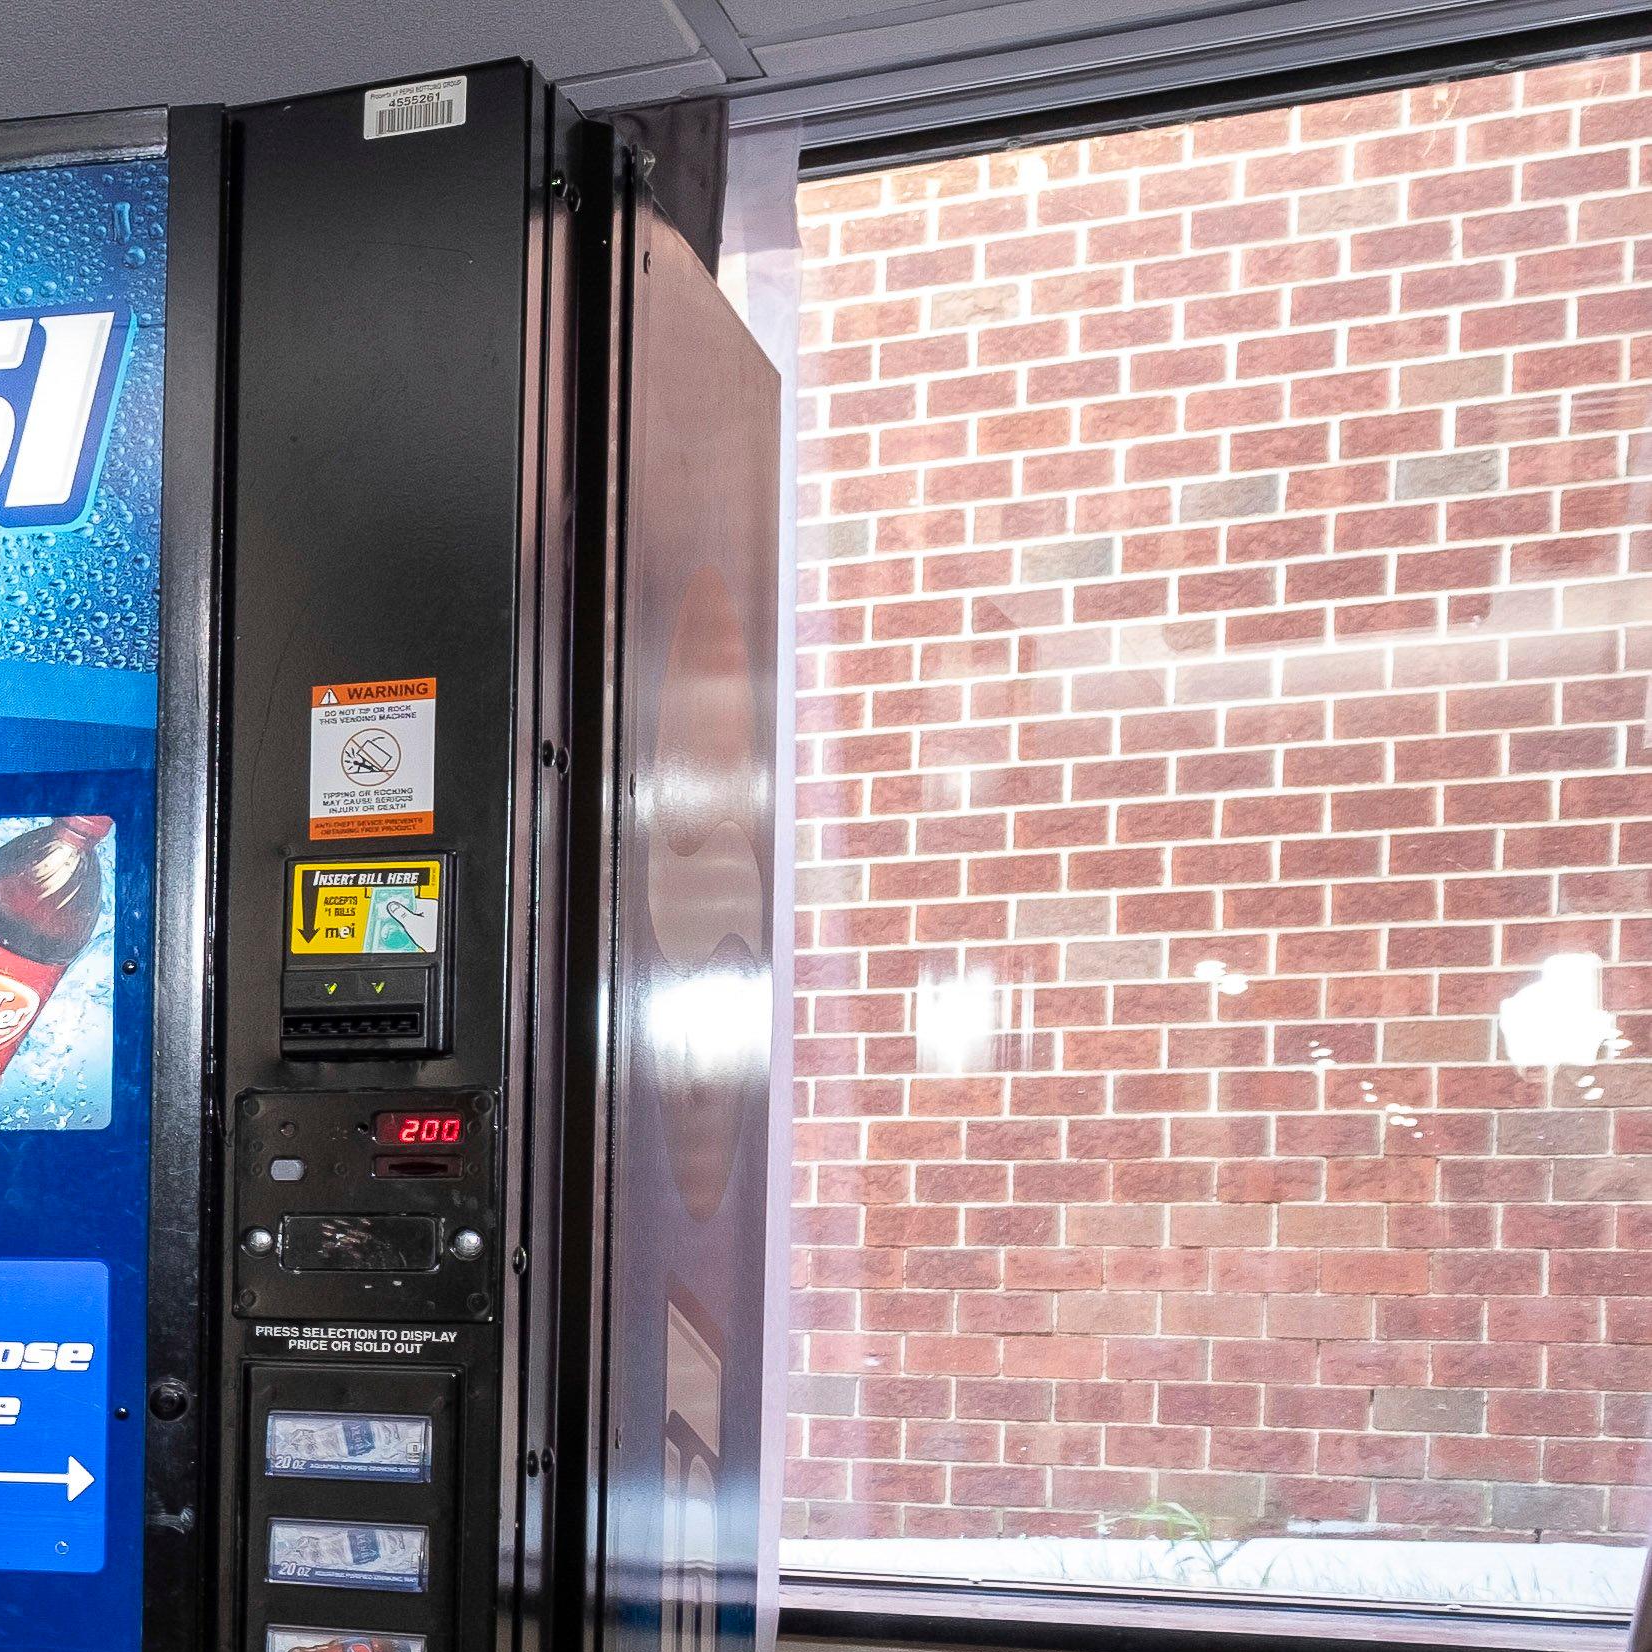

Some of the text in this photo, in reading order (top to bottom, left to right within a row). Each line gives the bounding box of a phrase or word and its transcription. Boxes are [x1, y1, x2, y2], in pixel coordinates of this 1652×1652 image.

[389, 92, 440, 107] 4555261
[347, 682, 429, 700] WARNING
[339, 708, 355, 716] NOT
[373, 706, 385, 714] OR
[388, 705, 412, 713] ROCK
[319, 711, 417, 725] THIS VENDING MACHINE
[323, 787, 413, 799] TIPPING OR ROCKING
[344, 798, 372, 806] CAUSE
[375, 795, 413, 804] SERIOUS
[329, 806, 359, 814] INJURY
[377, 803, 407, 811] DEATH
[313, 871, 354, 886] INSERT
[357, 872, 384, 885] BILL
[386, 872, 420, 884] HERE
[324, 896, 358, 906] ACCEPTS
[325, 923, 355, 939] mei
[399, 1119, 461, 1143] 200
[255, 1325, 458, 1343] PRESS SELECTION TO DISPLAY
[288, 1339, 423, 1354] PRICE OR SOLD OUT
[275, 1455, 291, 1469] 20
[278, 1562, 295, 1576] 20
